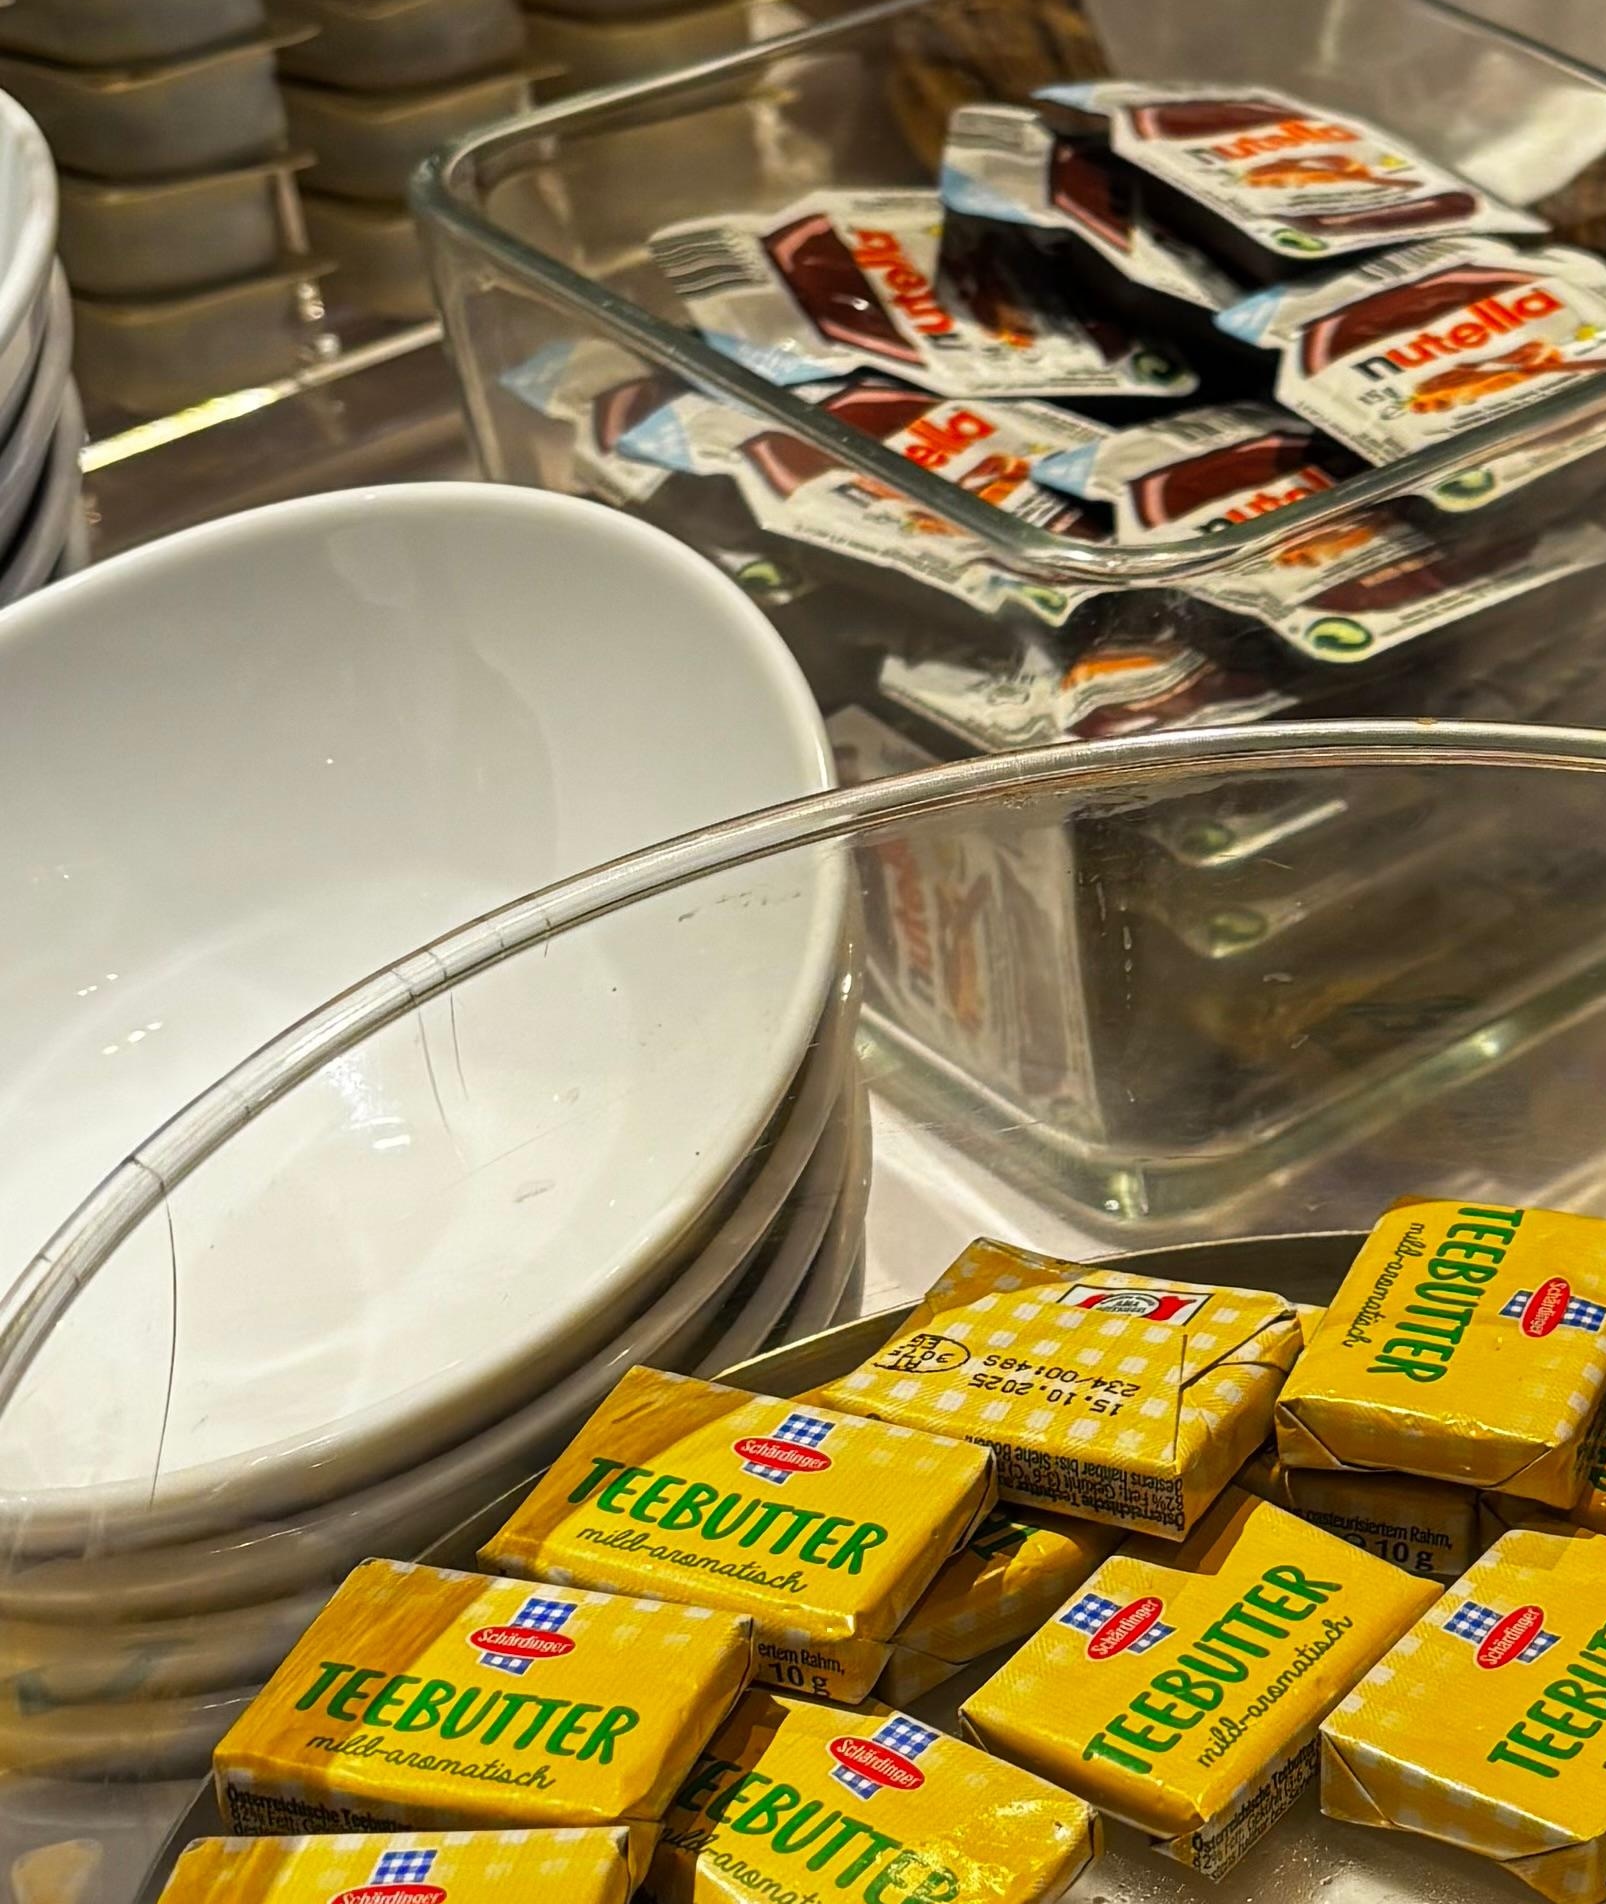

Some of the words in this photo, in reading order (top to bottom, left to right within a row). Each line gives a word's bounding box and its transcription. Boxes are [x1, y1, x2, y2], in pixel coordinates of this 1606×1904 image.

[1186, 118, 1361, 164] nutella
[1351, 287, 1564, 382] nutella
[902, 410, 998, 470] ella
[1342, 1223, 1427, 1349] mild-aromatisch
[1366, 1207, 1525, 1383] TEEBUTTER
[1530, 1281, 1568, 1336] Schärdinger
[967, 1369, 1123, 1417] 15.10.2025
[982, 1351, 1140, 1398] 234/00:48S
[739, 1438, 830, 1470] Schärdinger
[567, 1457, 889, 1575] TEEBUTTER
[1409, 1525, 1454, 1549] Rahm,
[577, 1524, 808, 1594] mild-aromatisch
[1374, 1538, 1410, 1563] 10
[1413, 1548, 1435, 1571] g
[475, 1628, 572, 1655] Schärdinger
[1090, 1598, 1161, 1658] Schärdinger
[1480, 1608, 1539, 1667] Schärdinger
[765, 1660, 806, 1687] 10
[809, 1675, 834, 1698] g
[1081, 1564, 1342, 1775] TEEBUTTER
[1198, 1615, 1354, 1768] mild-aromatisch
[294, 1661, 640, 1765] TEEBUTTER
[306, 1732, 556, 1791] mild-aromatisch
[836, 1738, 922, 1787] Schärdinger
